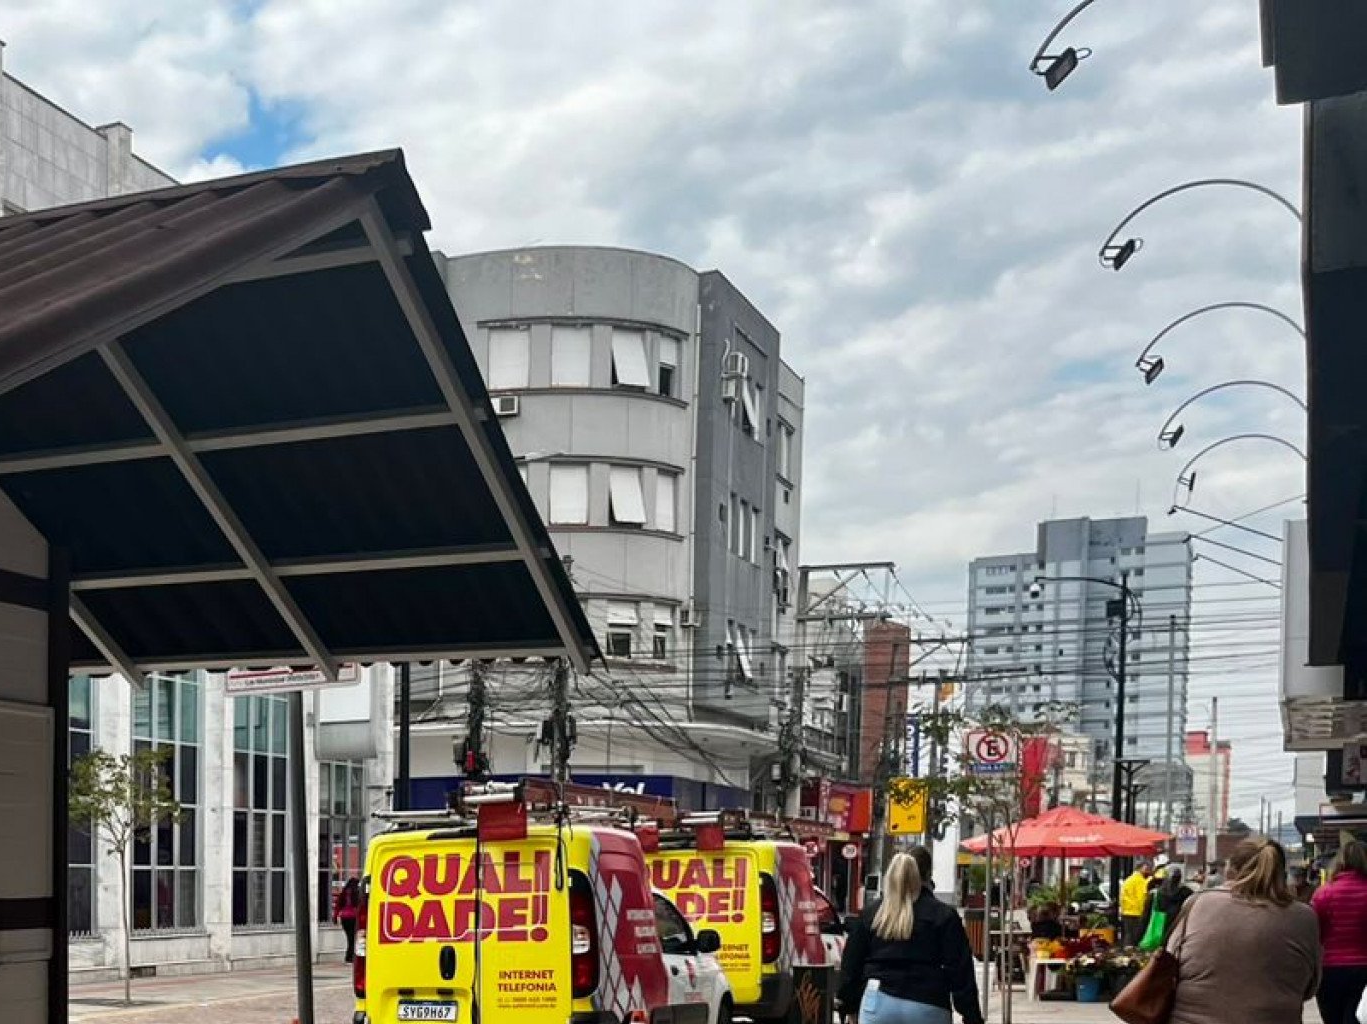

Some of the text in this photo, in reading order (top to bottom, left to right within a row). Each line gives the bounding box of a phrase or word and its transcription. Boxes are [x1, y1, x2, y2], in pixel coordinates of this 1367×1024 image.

[380, 851, 551, 898] QUALI
[652, 857, 747, 890] UALI
[378, 895, 548, 944] DADE!
[498, 982, 556, 992] TELEFONIA
[499, 969, 554, 980] INTERNET
